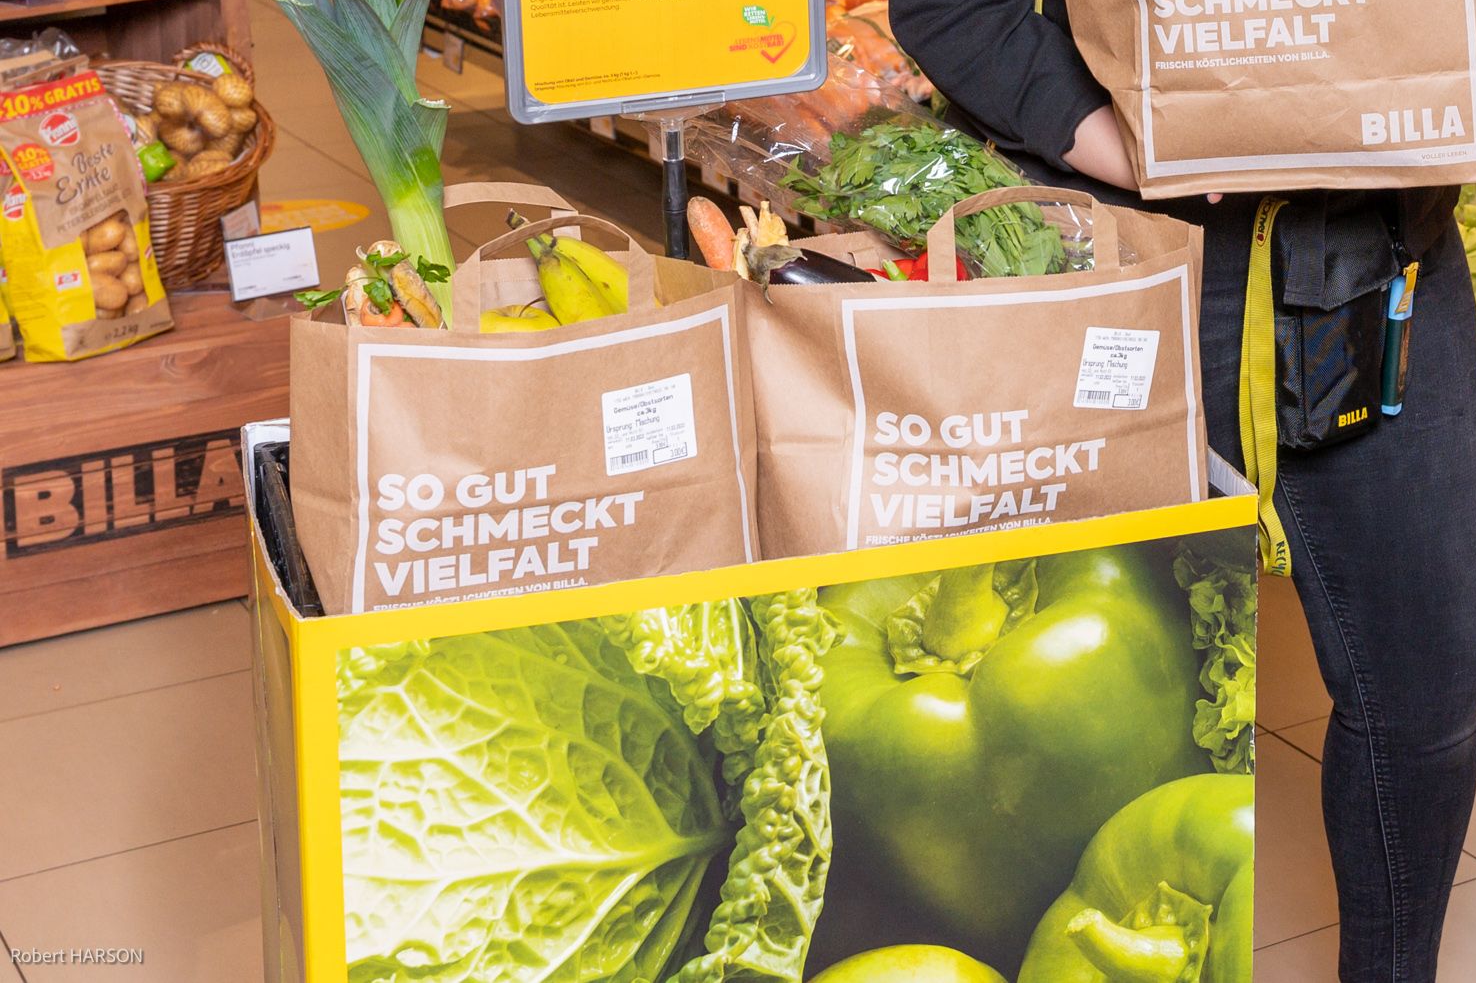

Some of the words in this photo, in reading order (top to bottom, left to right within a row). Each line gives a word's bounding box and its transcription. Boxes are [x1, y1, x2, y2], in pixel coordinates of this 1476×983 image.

[1155, 13, 1335, 54] VIELFALT
[1155, 60, 1194, 70] FRISCHE
[1196, 54, 1276, 68] KÖSTLICHKEITEN
[1278, 52, 1299, 64] VON
[1301, 49, 1331, 61] BILLA.
[44, 77, 101, 104] GRATIS
[1361, 106, 1465, 145] BILLA
[72, 143, 113, 175] Beste
[56, 167, 111, 205] Ernte
[1107, 360, 1128, 370] Mischung
[635, 416, 660, 427] Mischung
[874, 411, 931, 446] SO
[940, 409, 1029, 449] GUT
[1338, 406, 1369, 428] BILLA
[872, 438, 1106, 487] SCHMECKT
[14, 439, 244, 548] BILLA
[377, 473, 444, 511] SO
[456, 464, 556, 508] GUT
[870, 483, 1067, 528] VIELFALT
[375, 490, 644, 555] SCHMECKT
[866, 535, 910, 545] FRISCHE
[999, 521, 1021, 531] VON
[373, 536, 598, 596] VIELFALT
[526, 582, 551, 595] VON
[553, 576, 588, 591] BILLA.
